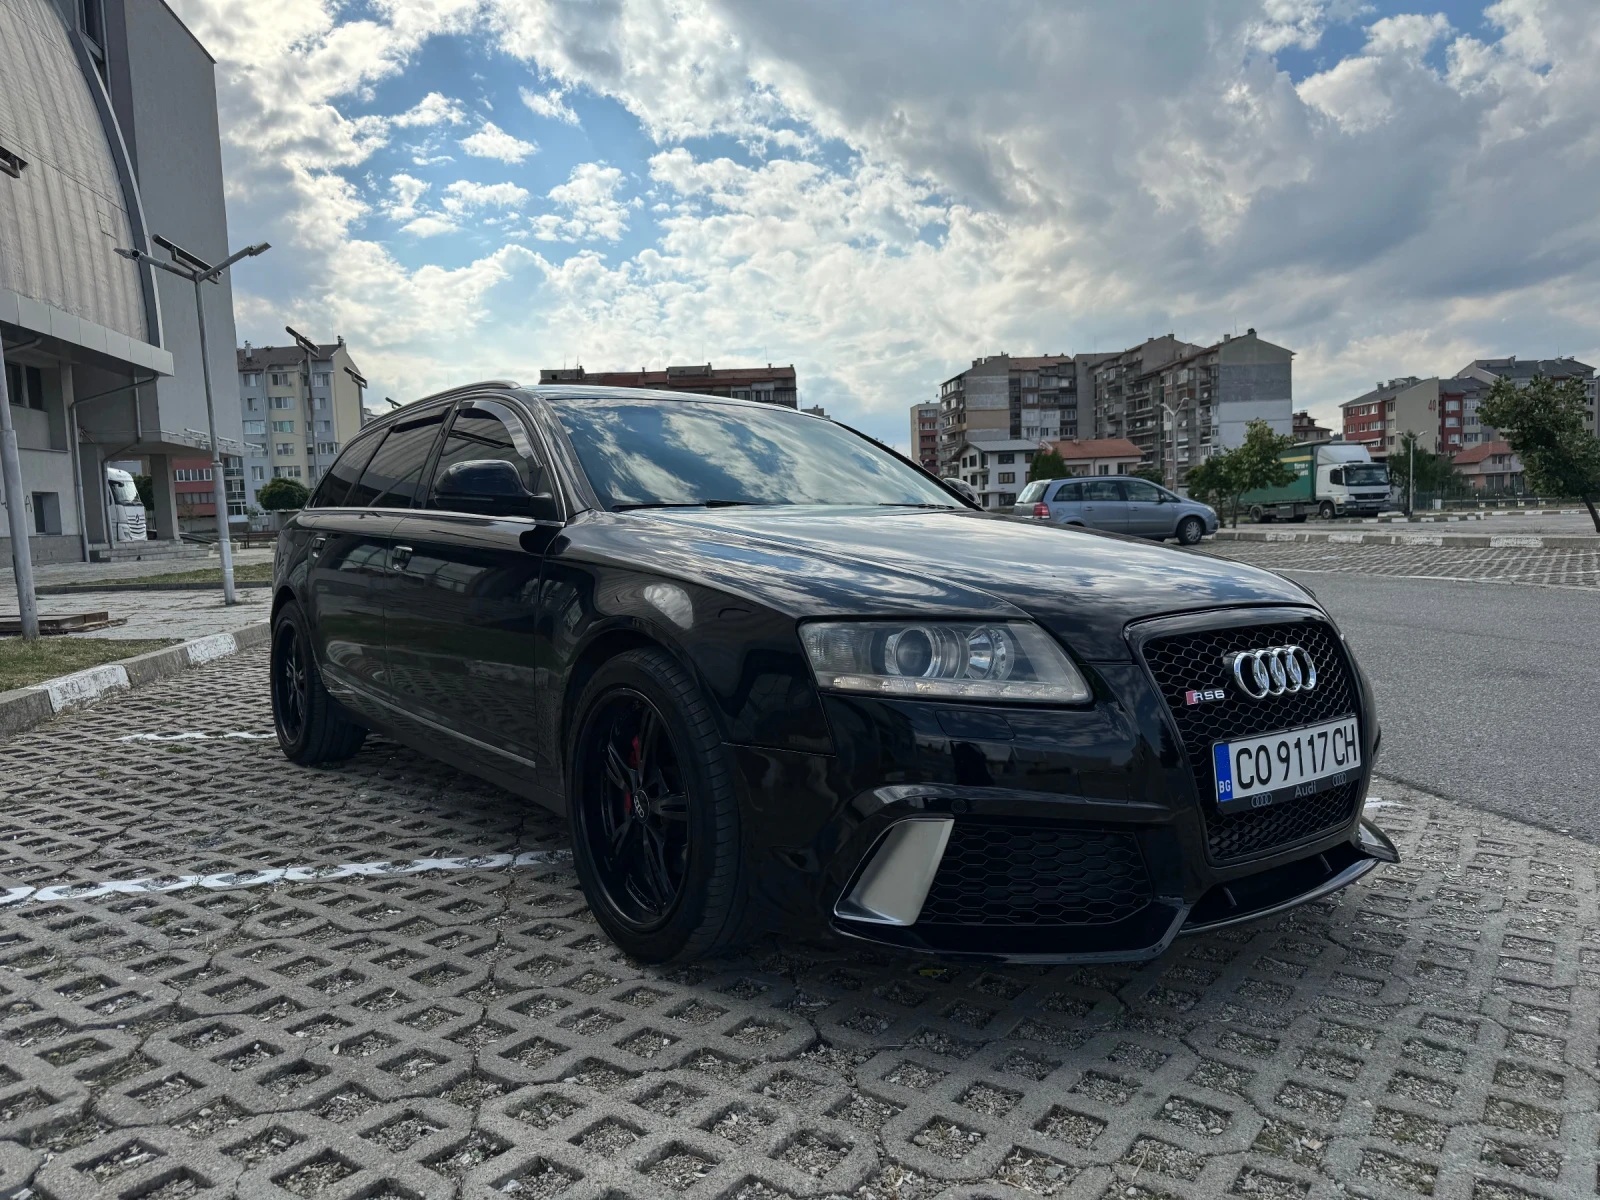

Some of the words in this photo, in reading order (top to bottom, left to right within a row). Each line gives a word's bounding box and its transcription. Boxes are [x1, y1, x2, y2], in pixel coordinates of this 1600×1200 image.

[1428, 399, 1436, 411] 40
[1193, 690, 1225, 702] RS6
[1277, 731, 1328, 781] 9117
[1333, 723, 1357, 766] CH
[1219, 780, 1231, 793] BG
[1295, 781, 1317, 798] Audi
